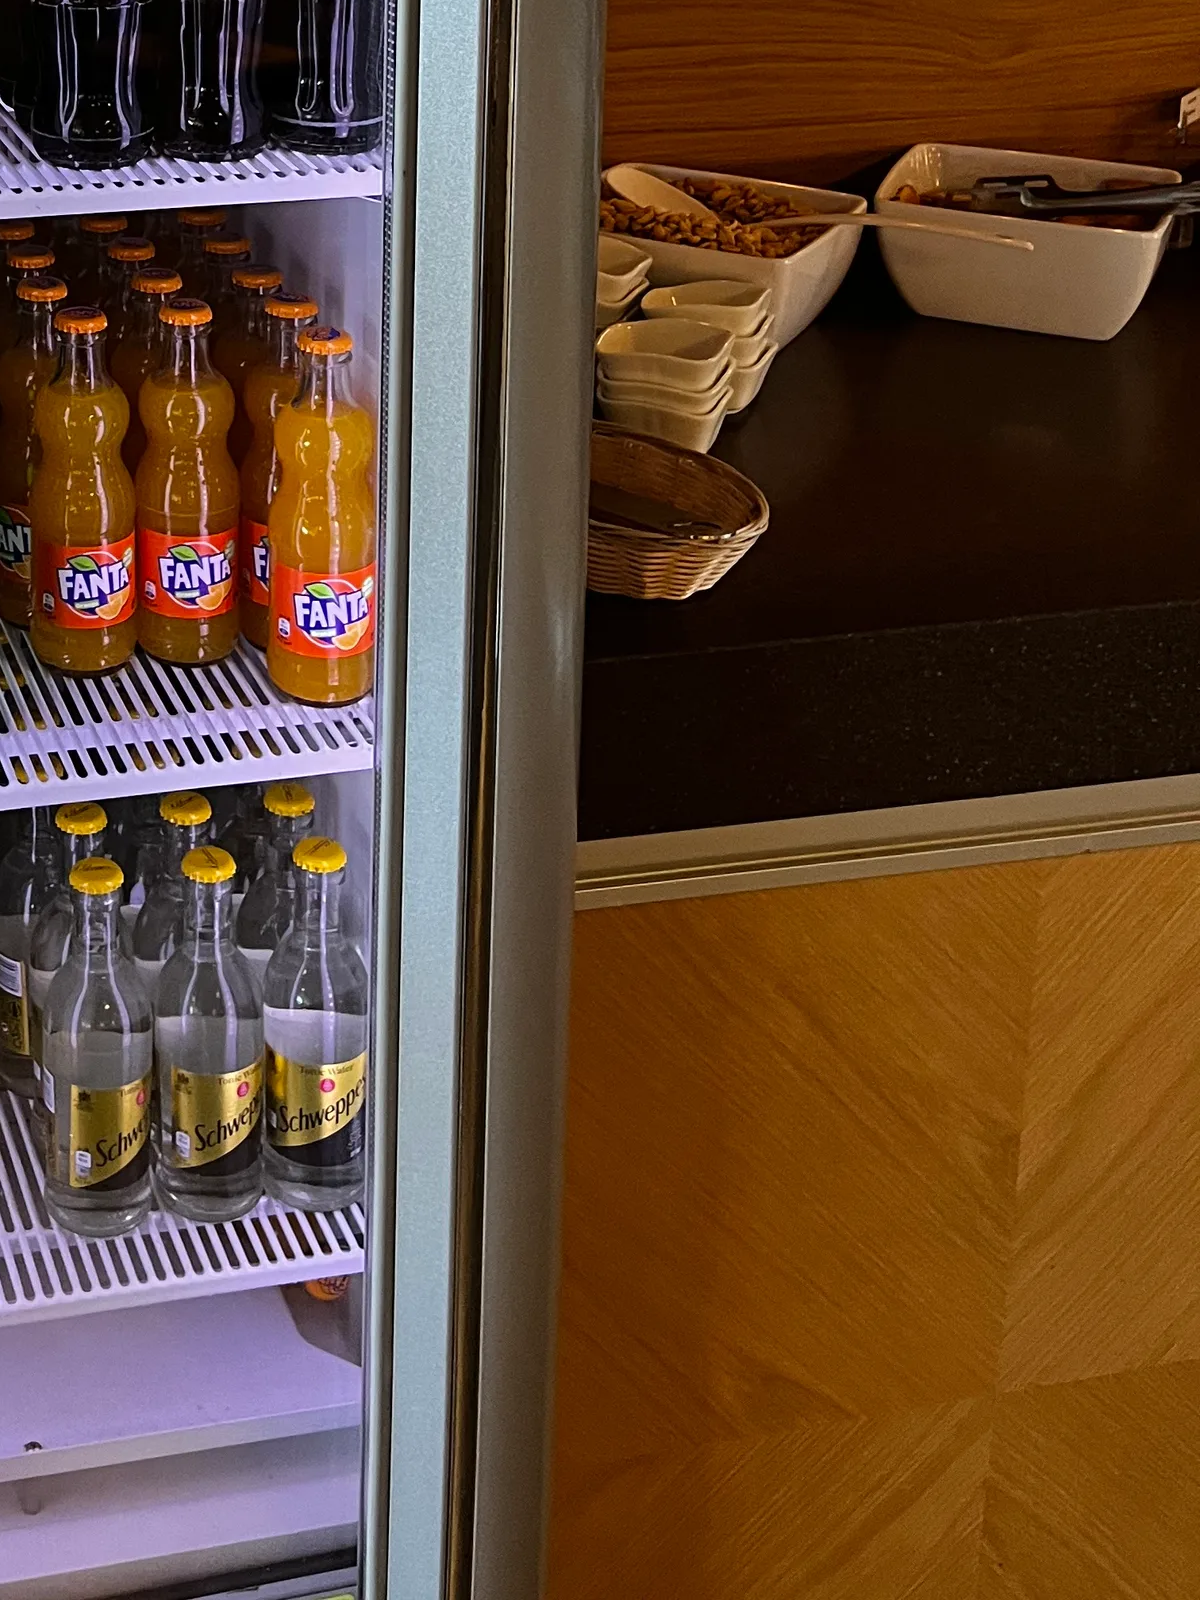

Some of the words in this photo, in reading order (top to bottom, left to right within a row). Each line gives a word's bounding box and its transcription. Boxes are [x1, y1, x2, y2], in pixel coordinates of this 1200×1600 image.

[58, 561, 129, 600] FANTA
[159, 553, 231, 589] FANTA
[294, 591, 368, 628] FANTA
